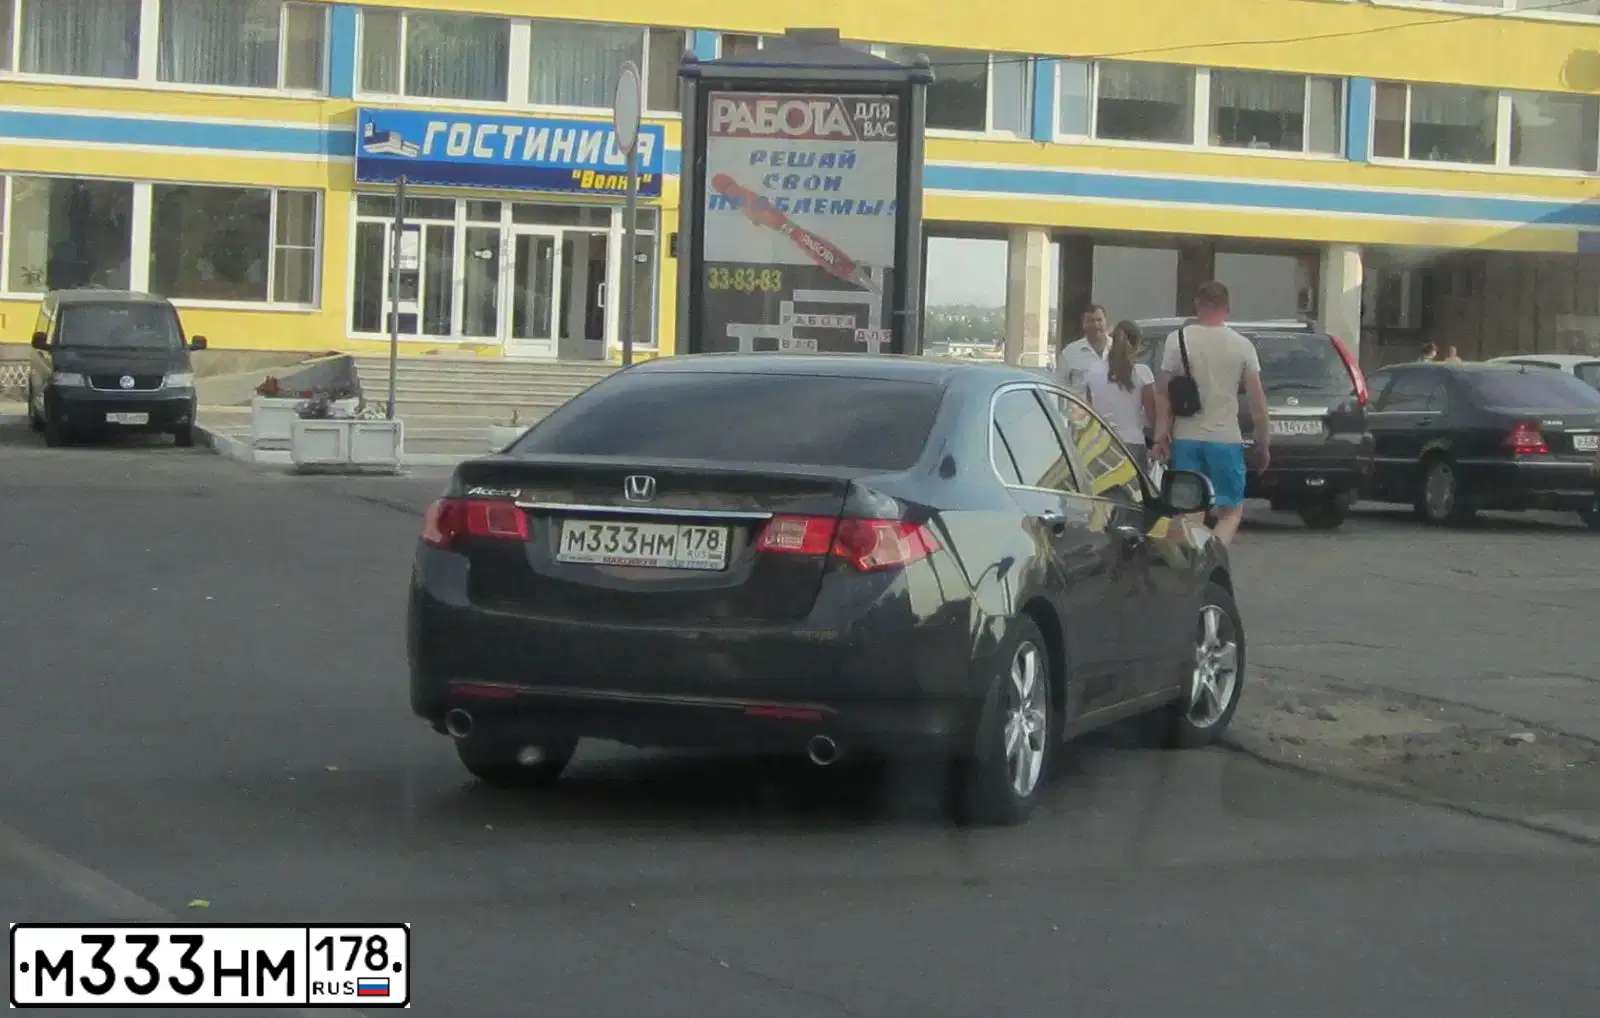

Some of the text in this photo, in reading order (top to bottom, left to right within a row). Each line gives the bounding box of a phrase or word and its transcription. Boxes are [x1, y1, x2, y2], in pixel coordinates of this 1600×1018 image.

[711, 98, 852, 136] РАБОТА
[854, 102, 890, 121] ДЛЯ
[863, 120, 897, 138] ВАС
[750, 149, 857, 169] РЕШАЙ
[762, 172, 843, 192] СВОИ
[783, 315, 856, 327] РАБОТА
[856, 330, 892, 342] ДЛЯ
[567, 525, 719, 556] М333НМ 178
